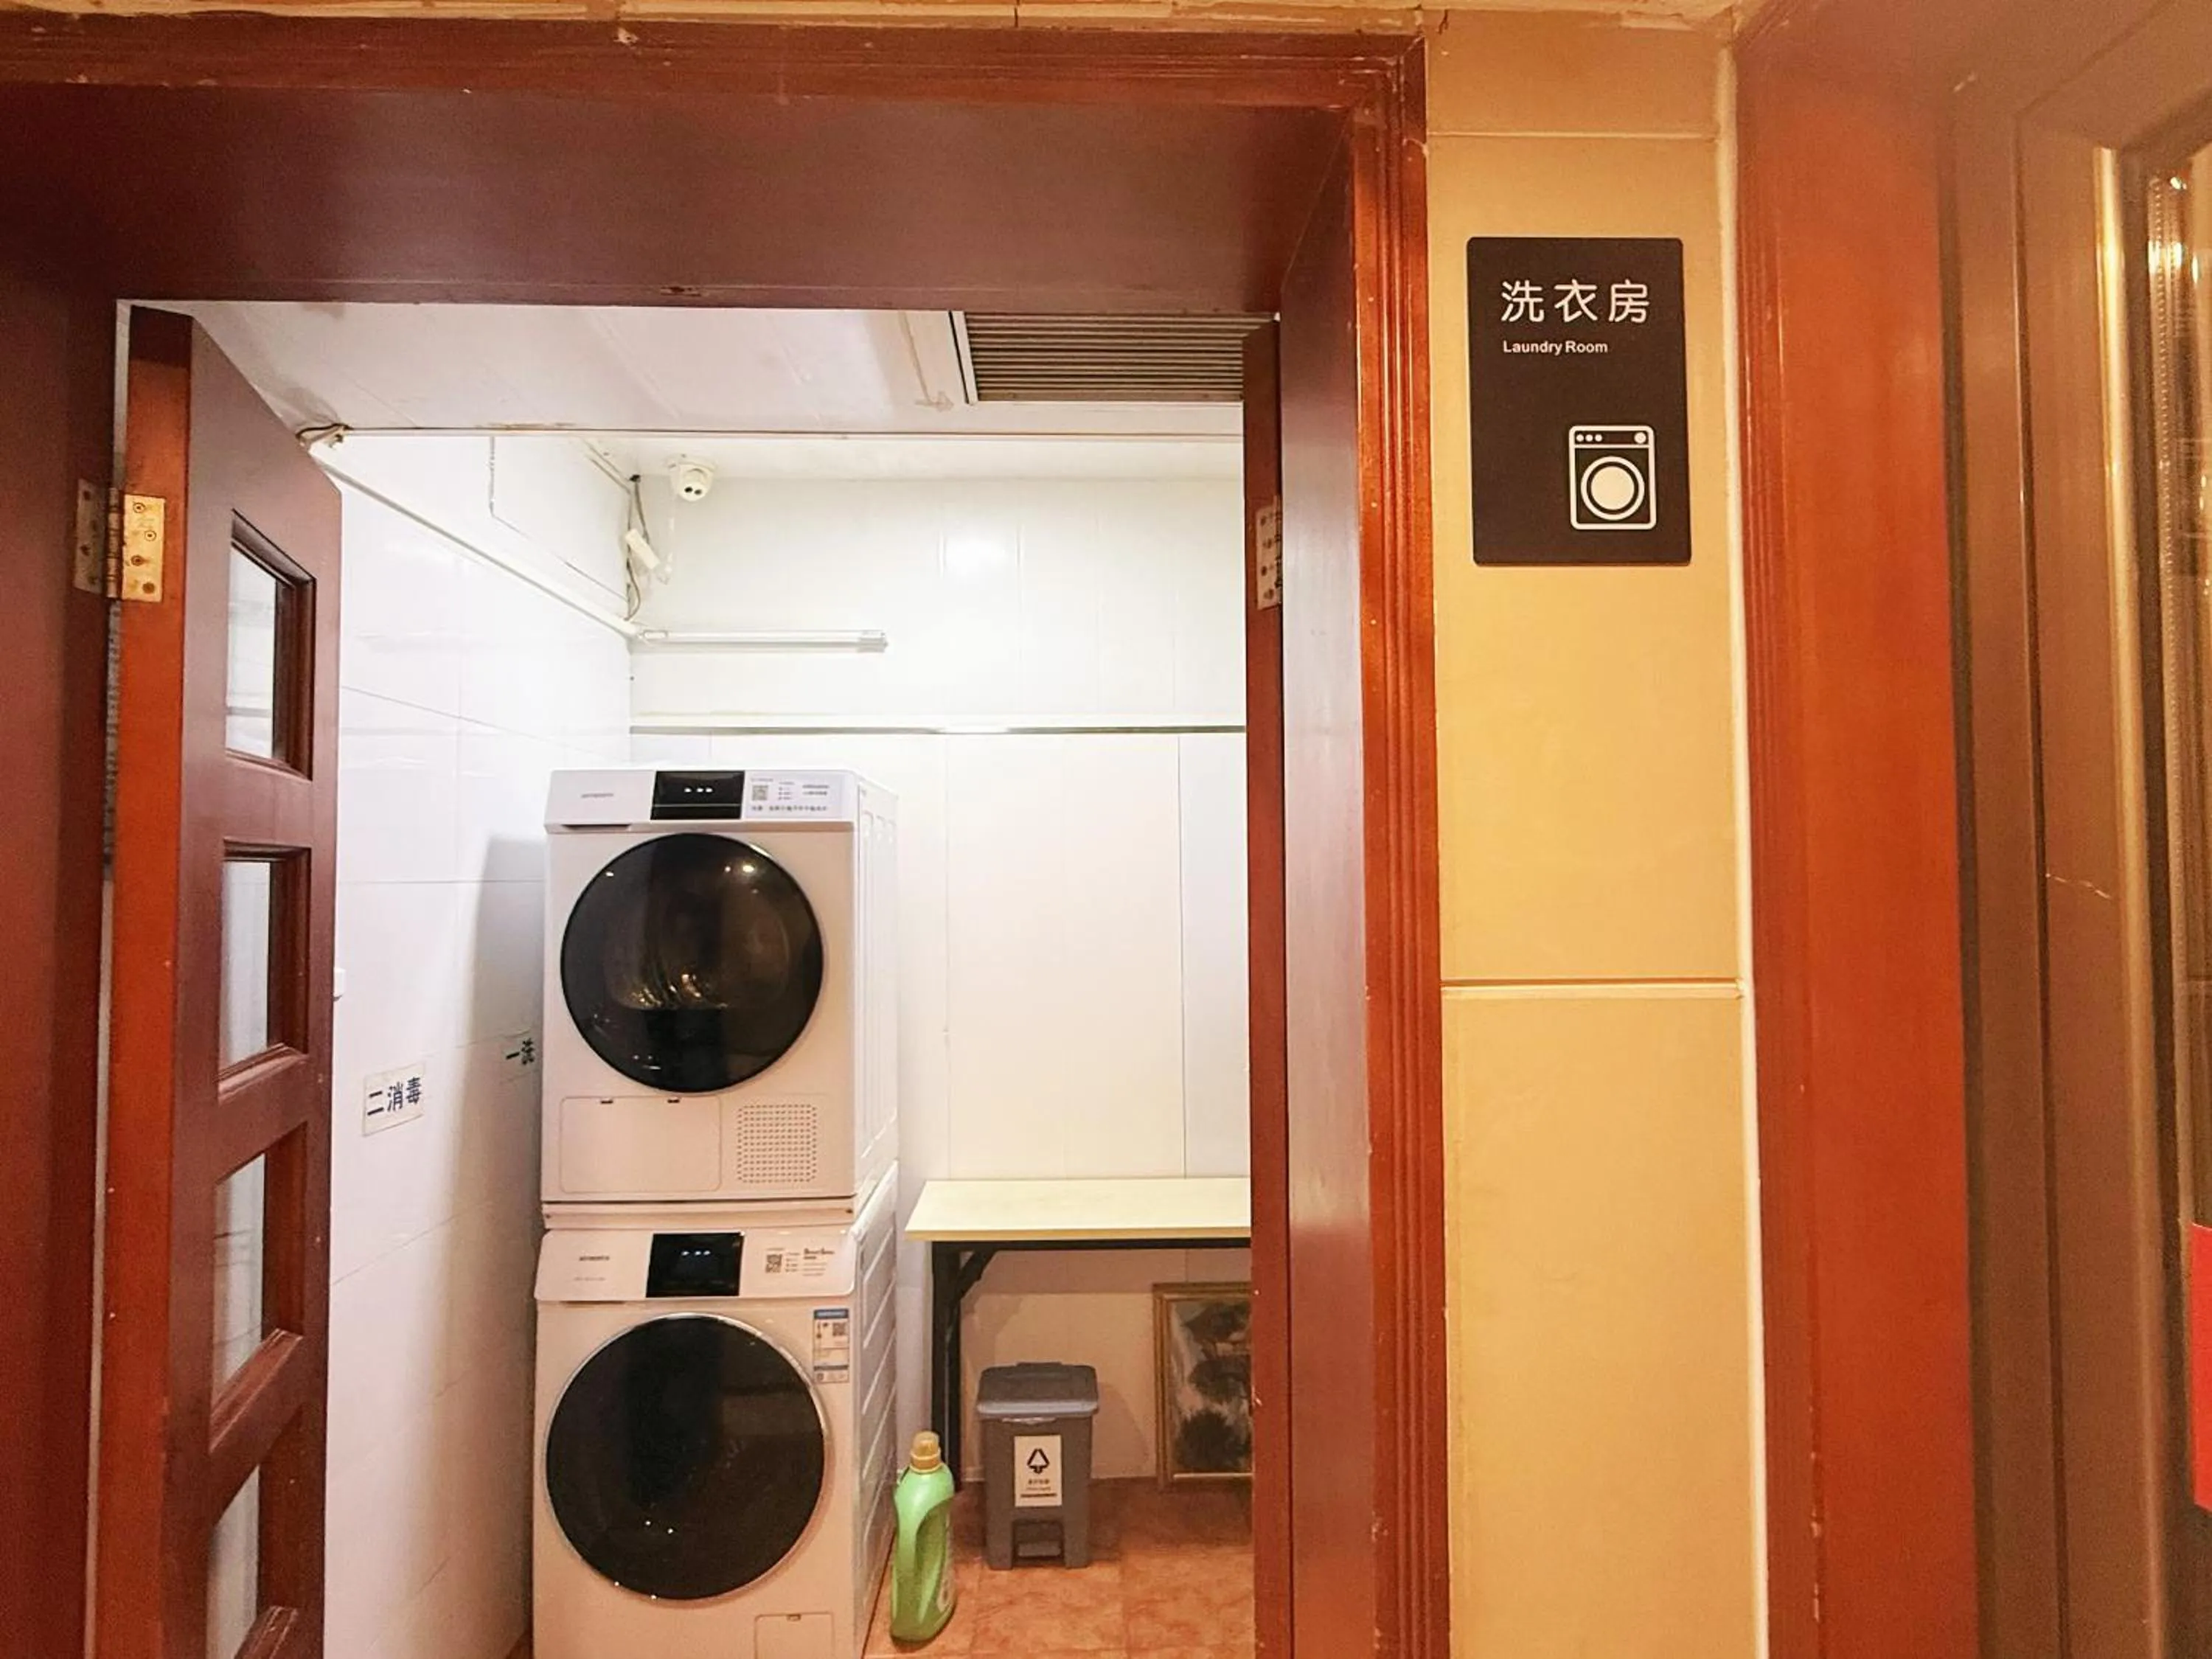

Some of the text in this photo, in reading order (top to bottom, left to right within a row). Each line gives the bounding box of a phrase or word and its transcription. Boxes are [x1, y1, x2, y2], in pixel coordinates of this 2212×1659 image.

[1500, 278, 1650, 324] 洗衣房
[1503, 340, 1609, 356] Laundry Room
[367, 1076, 422, 1116] 二消毒
